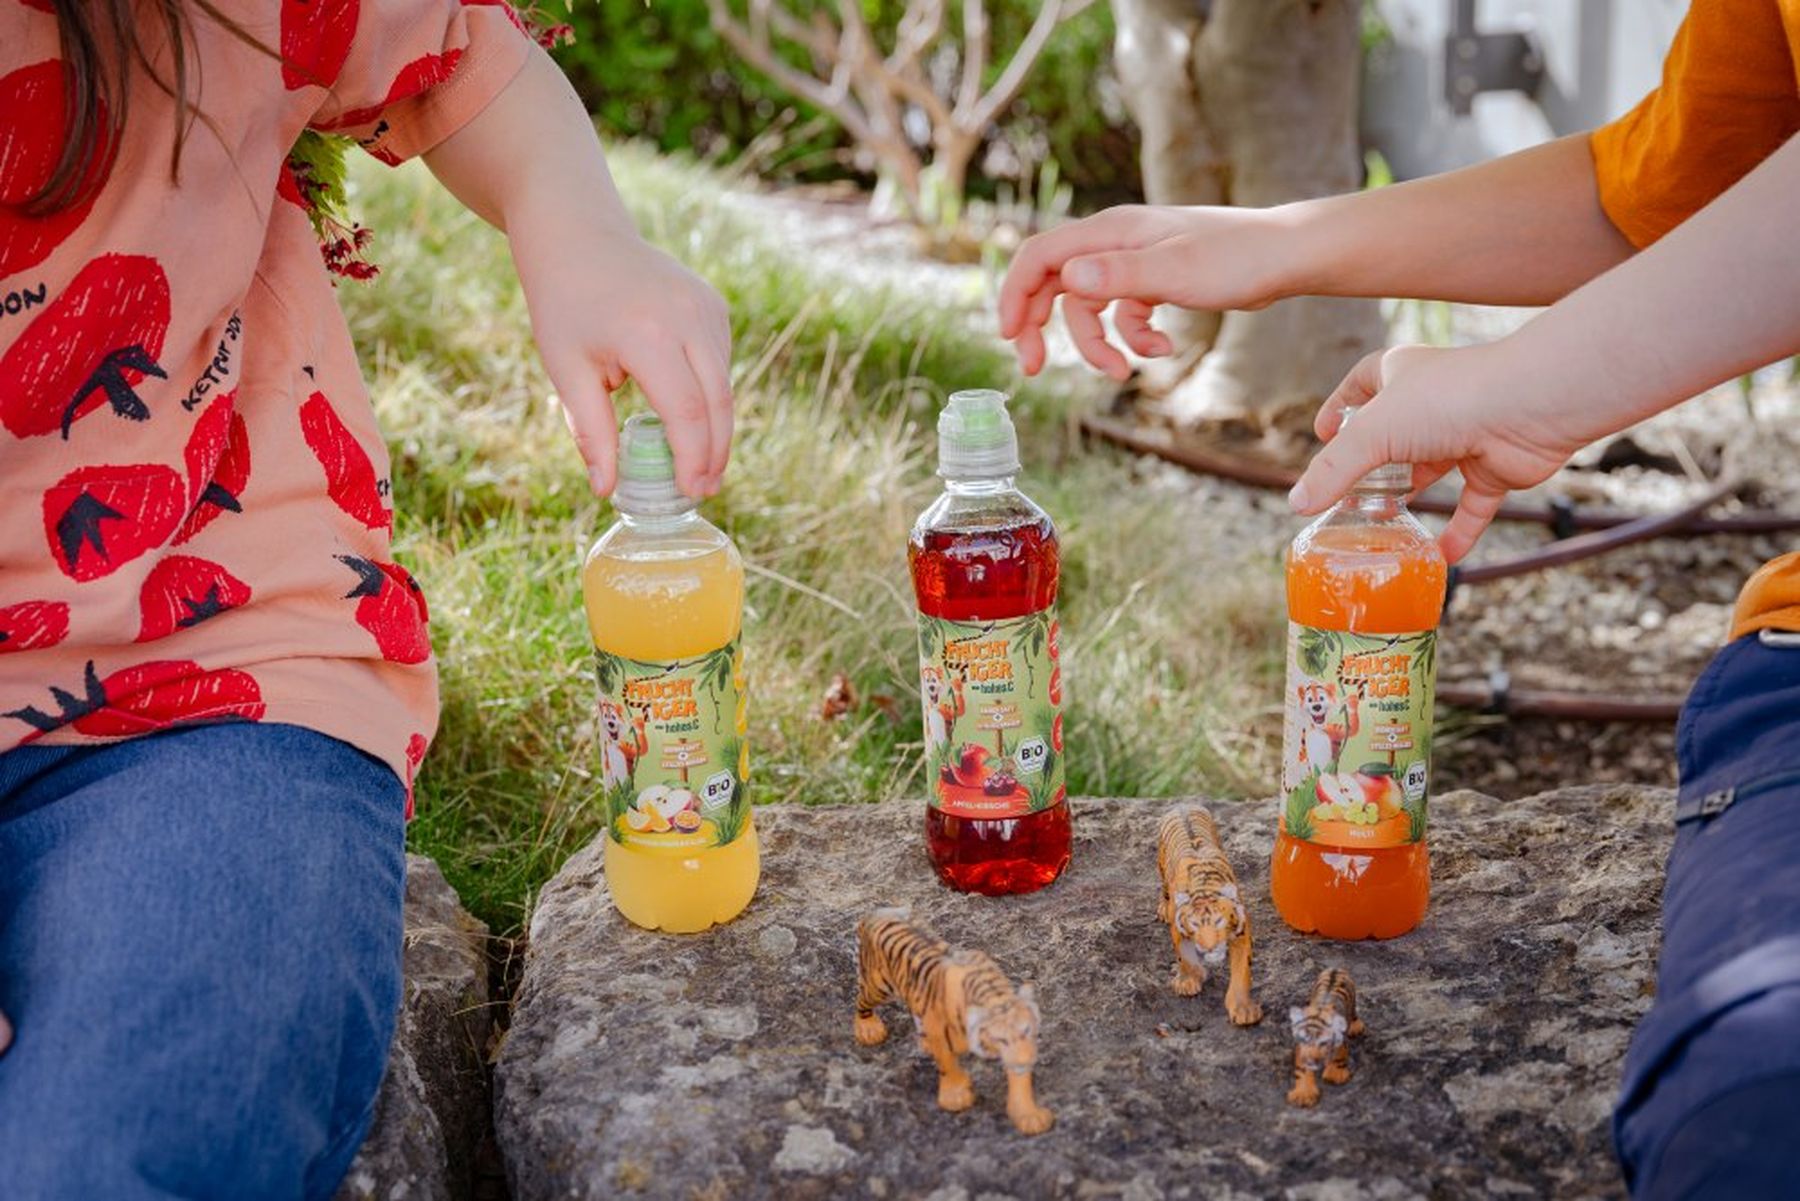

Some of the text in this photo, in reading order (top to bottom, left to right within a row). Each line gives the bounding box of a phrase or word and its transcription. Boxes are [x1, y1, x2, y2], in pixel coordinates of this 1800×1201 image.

[945, 640, 1010, 660] FRUCHT
[1342, 655, 1411, 676] FRUCHT
[626, 679, 695, 700] FRUCHT
